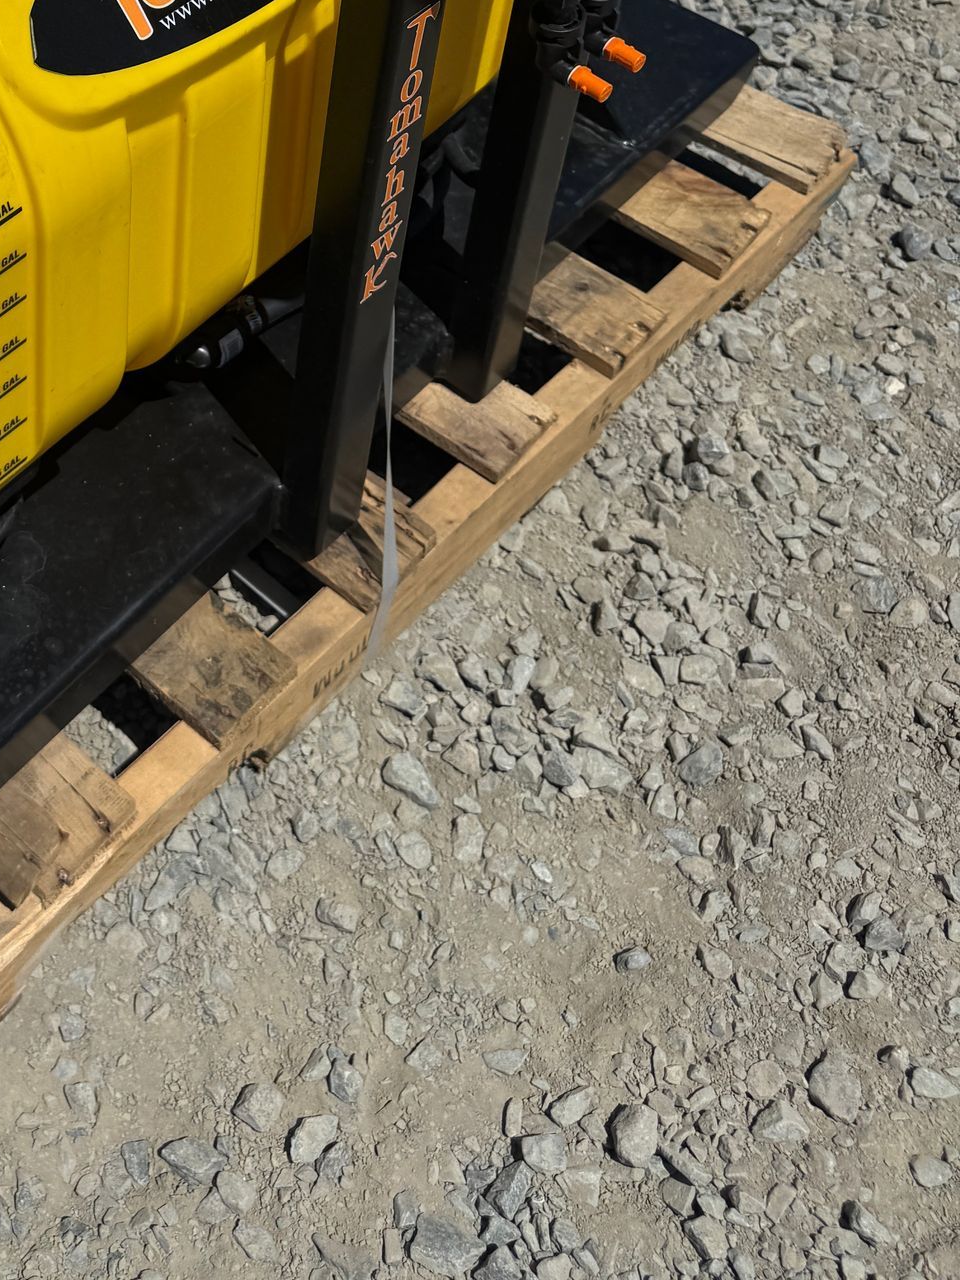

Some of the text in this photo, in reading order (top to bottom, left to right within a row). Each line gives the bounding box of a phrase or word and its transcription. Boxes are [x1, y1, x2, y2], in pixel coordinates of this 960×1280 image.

[359, 1, 440, 304] Tomahawk
[1, 249, 20, 267] GAL
[1, 292, 20, 309] GAL
[2, 336, 20, 352] GAL
[2, 374, 21, 391] GAL
[3, 415, 21, 433] GAL
[3, 456, 21, 472] GAL
